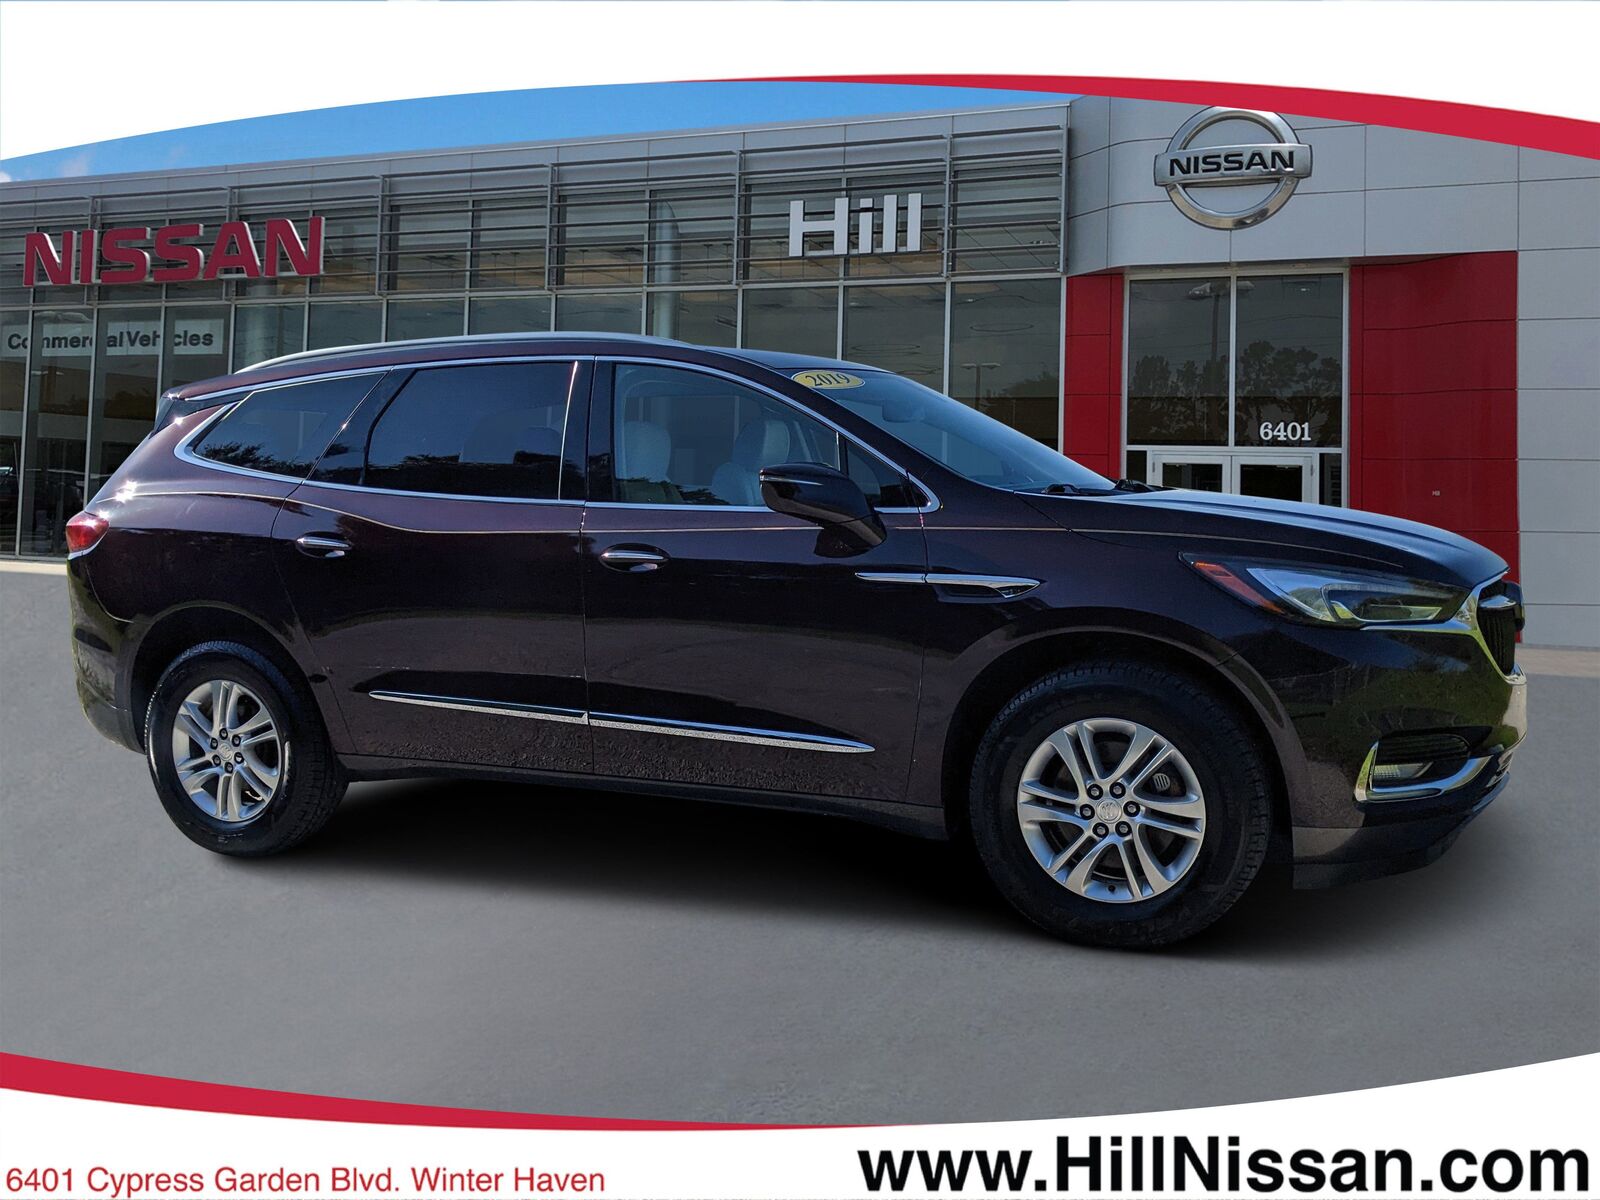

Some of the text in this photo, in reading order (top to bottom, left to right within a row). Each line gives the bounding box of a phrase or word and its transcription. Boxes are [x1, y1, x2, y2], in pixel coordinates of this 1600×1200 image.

[1168, 150, 1295, 177] NISSAN
[788, 192, 922, 257] Hill
[23, 215, 325, 287] NISSAN
[7, 329, 214, 350] Commeral Vehcles
[804, 371, 851, 387] 2019
[1259, 421, 1312, 441] 6401
